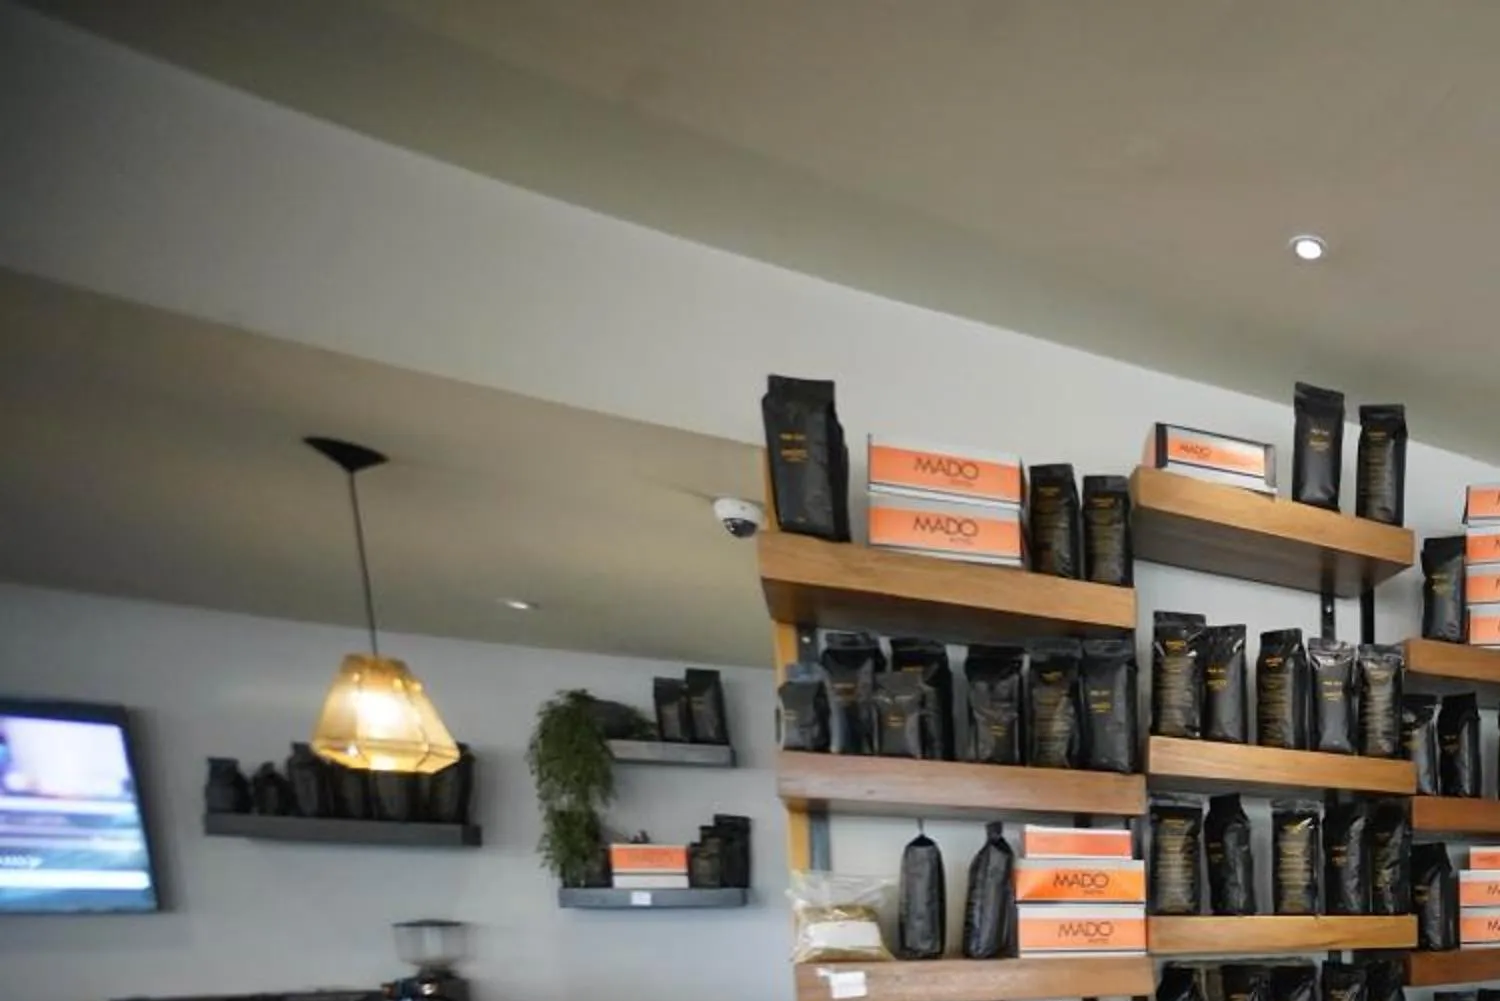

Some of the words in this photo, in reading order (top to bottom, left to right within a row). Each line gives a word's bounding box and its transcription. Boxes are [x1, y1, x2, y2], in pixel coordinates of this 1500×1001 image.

[914, 456, 979, 480] MADO
[913, 515, 979, 537] MADO
[1052, 871, 1110, 889] MADO
[1058, 921, 1115, 938] MADO
